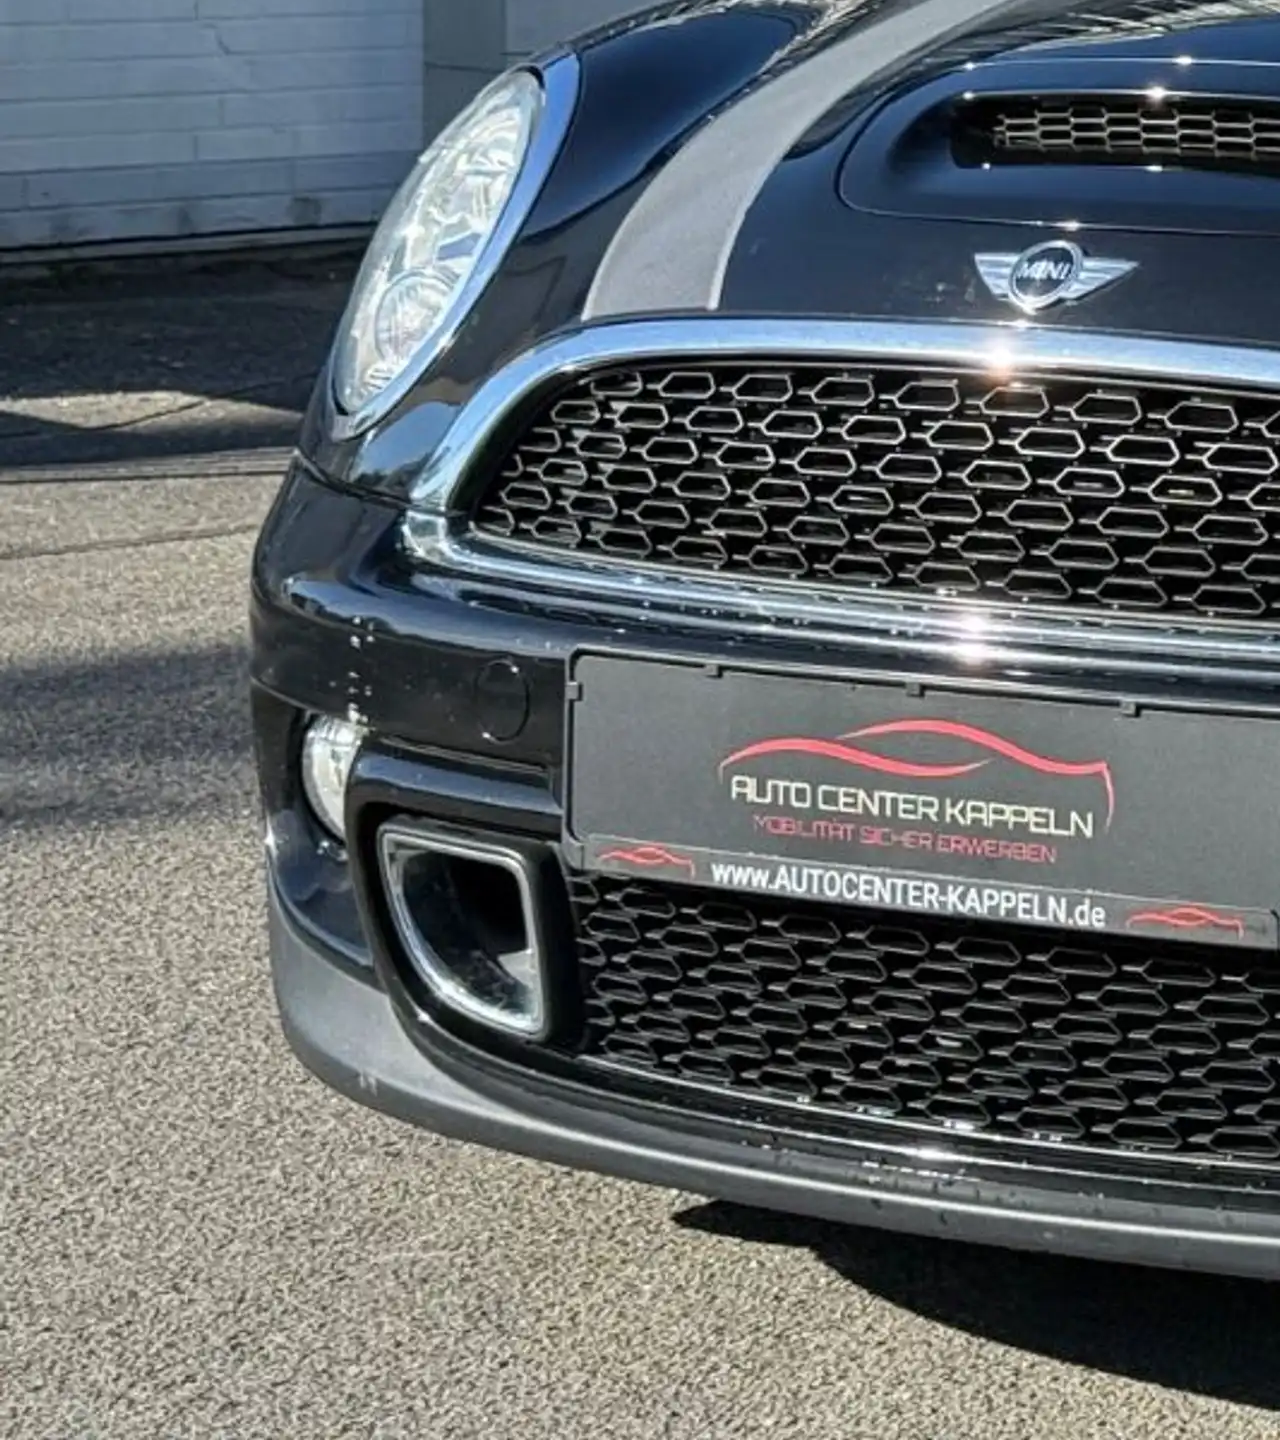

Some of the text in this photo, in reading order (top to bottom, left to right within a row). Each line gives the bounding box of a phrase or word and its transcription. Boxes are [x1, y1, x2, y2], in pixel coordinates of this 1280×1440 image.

[1016, 257, 1072, 280] MINI
[731, 775, 1093, 839] AUTO CENTER KAPPELN
[711, 863, 1107, 928] www.AUTOCENTER-KAPPELN.de
